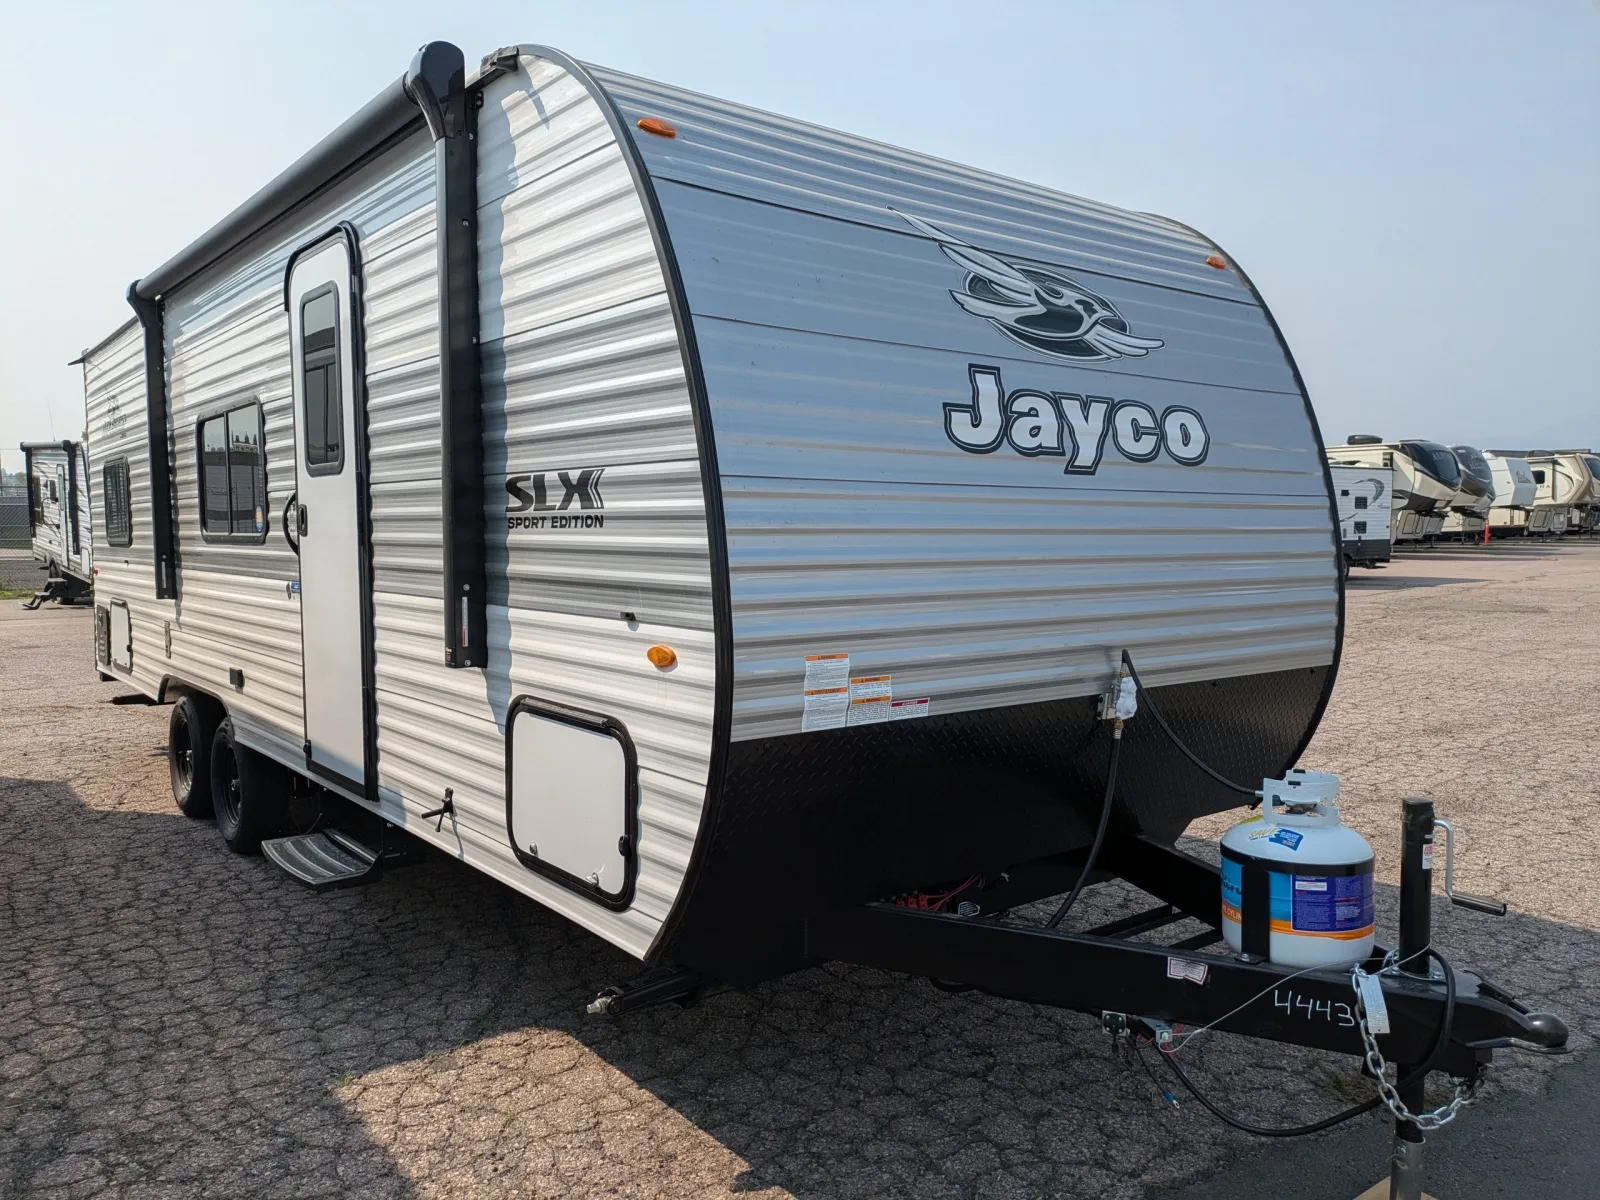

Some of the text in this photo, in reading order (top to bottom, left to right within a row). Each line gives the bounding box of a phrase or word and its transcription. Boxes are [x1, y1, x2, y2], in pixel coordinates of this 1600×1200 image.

[942, 363, 1210, 475] Jayco
[505, 468, 605, 512] SLX
[508, 515, 604, 529] SPORT EDITION
[1274, 990, 1354, 1026] 4443
